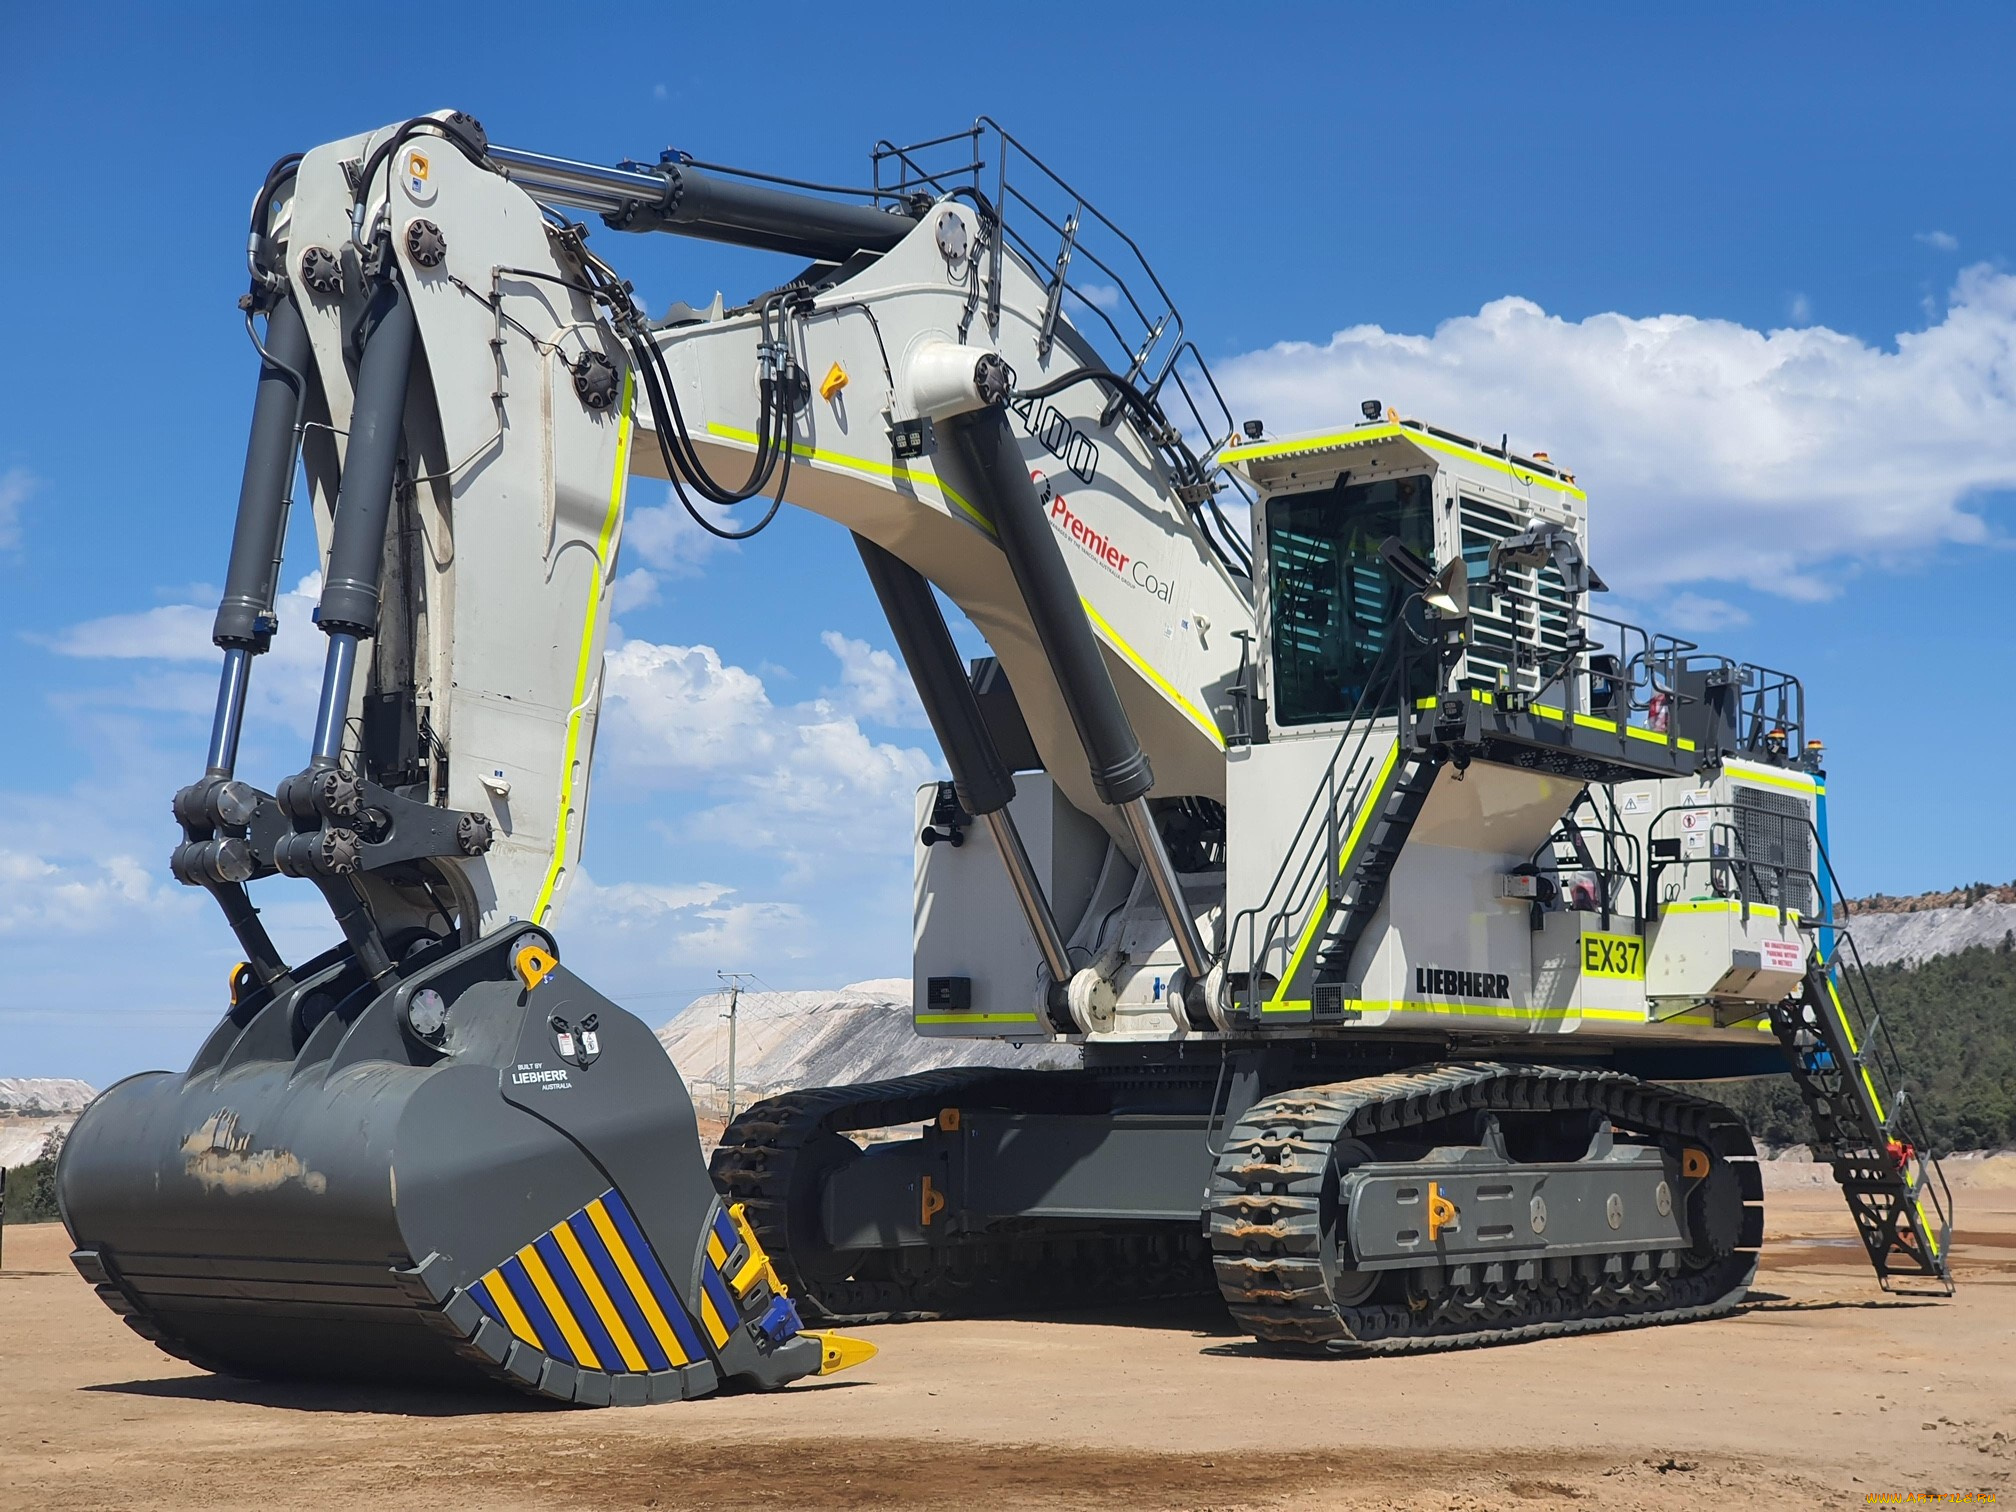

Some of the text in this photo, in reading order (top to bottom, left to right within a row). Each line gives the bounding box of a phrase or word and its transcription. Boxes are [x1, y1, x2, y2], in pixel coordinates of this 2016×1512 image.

[1001, 357, 1099, 485] 400
[1051, 494, 1175, 605] Premier Coal
[1584, 937, 1640, 975] EX37
[1416, 967, 1510, 999] LIEBHERR
[512, 1070, 568, 1084] LIEBHERR
[542, 1083, 572, 1091] AUSTRALIA
